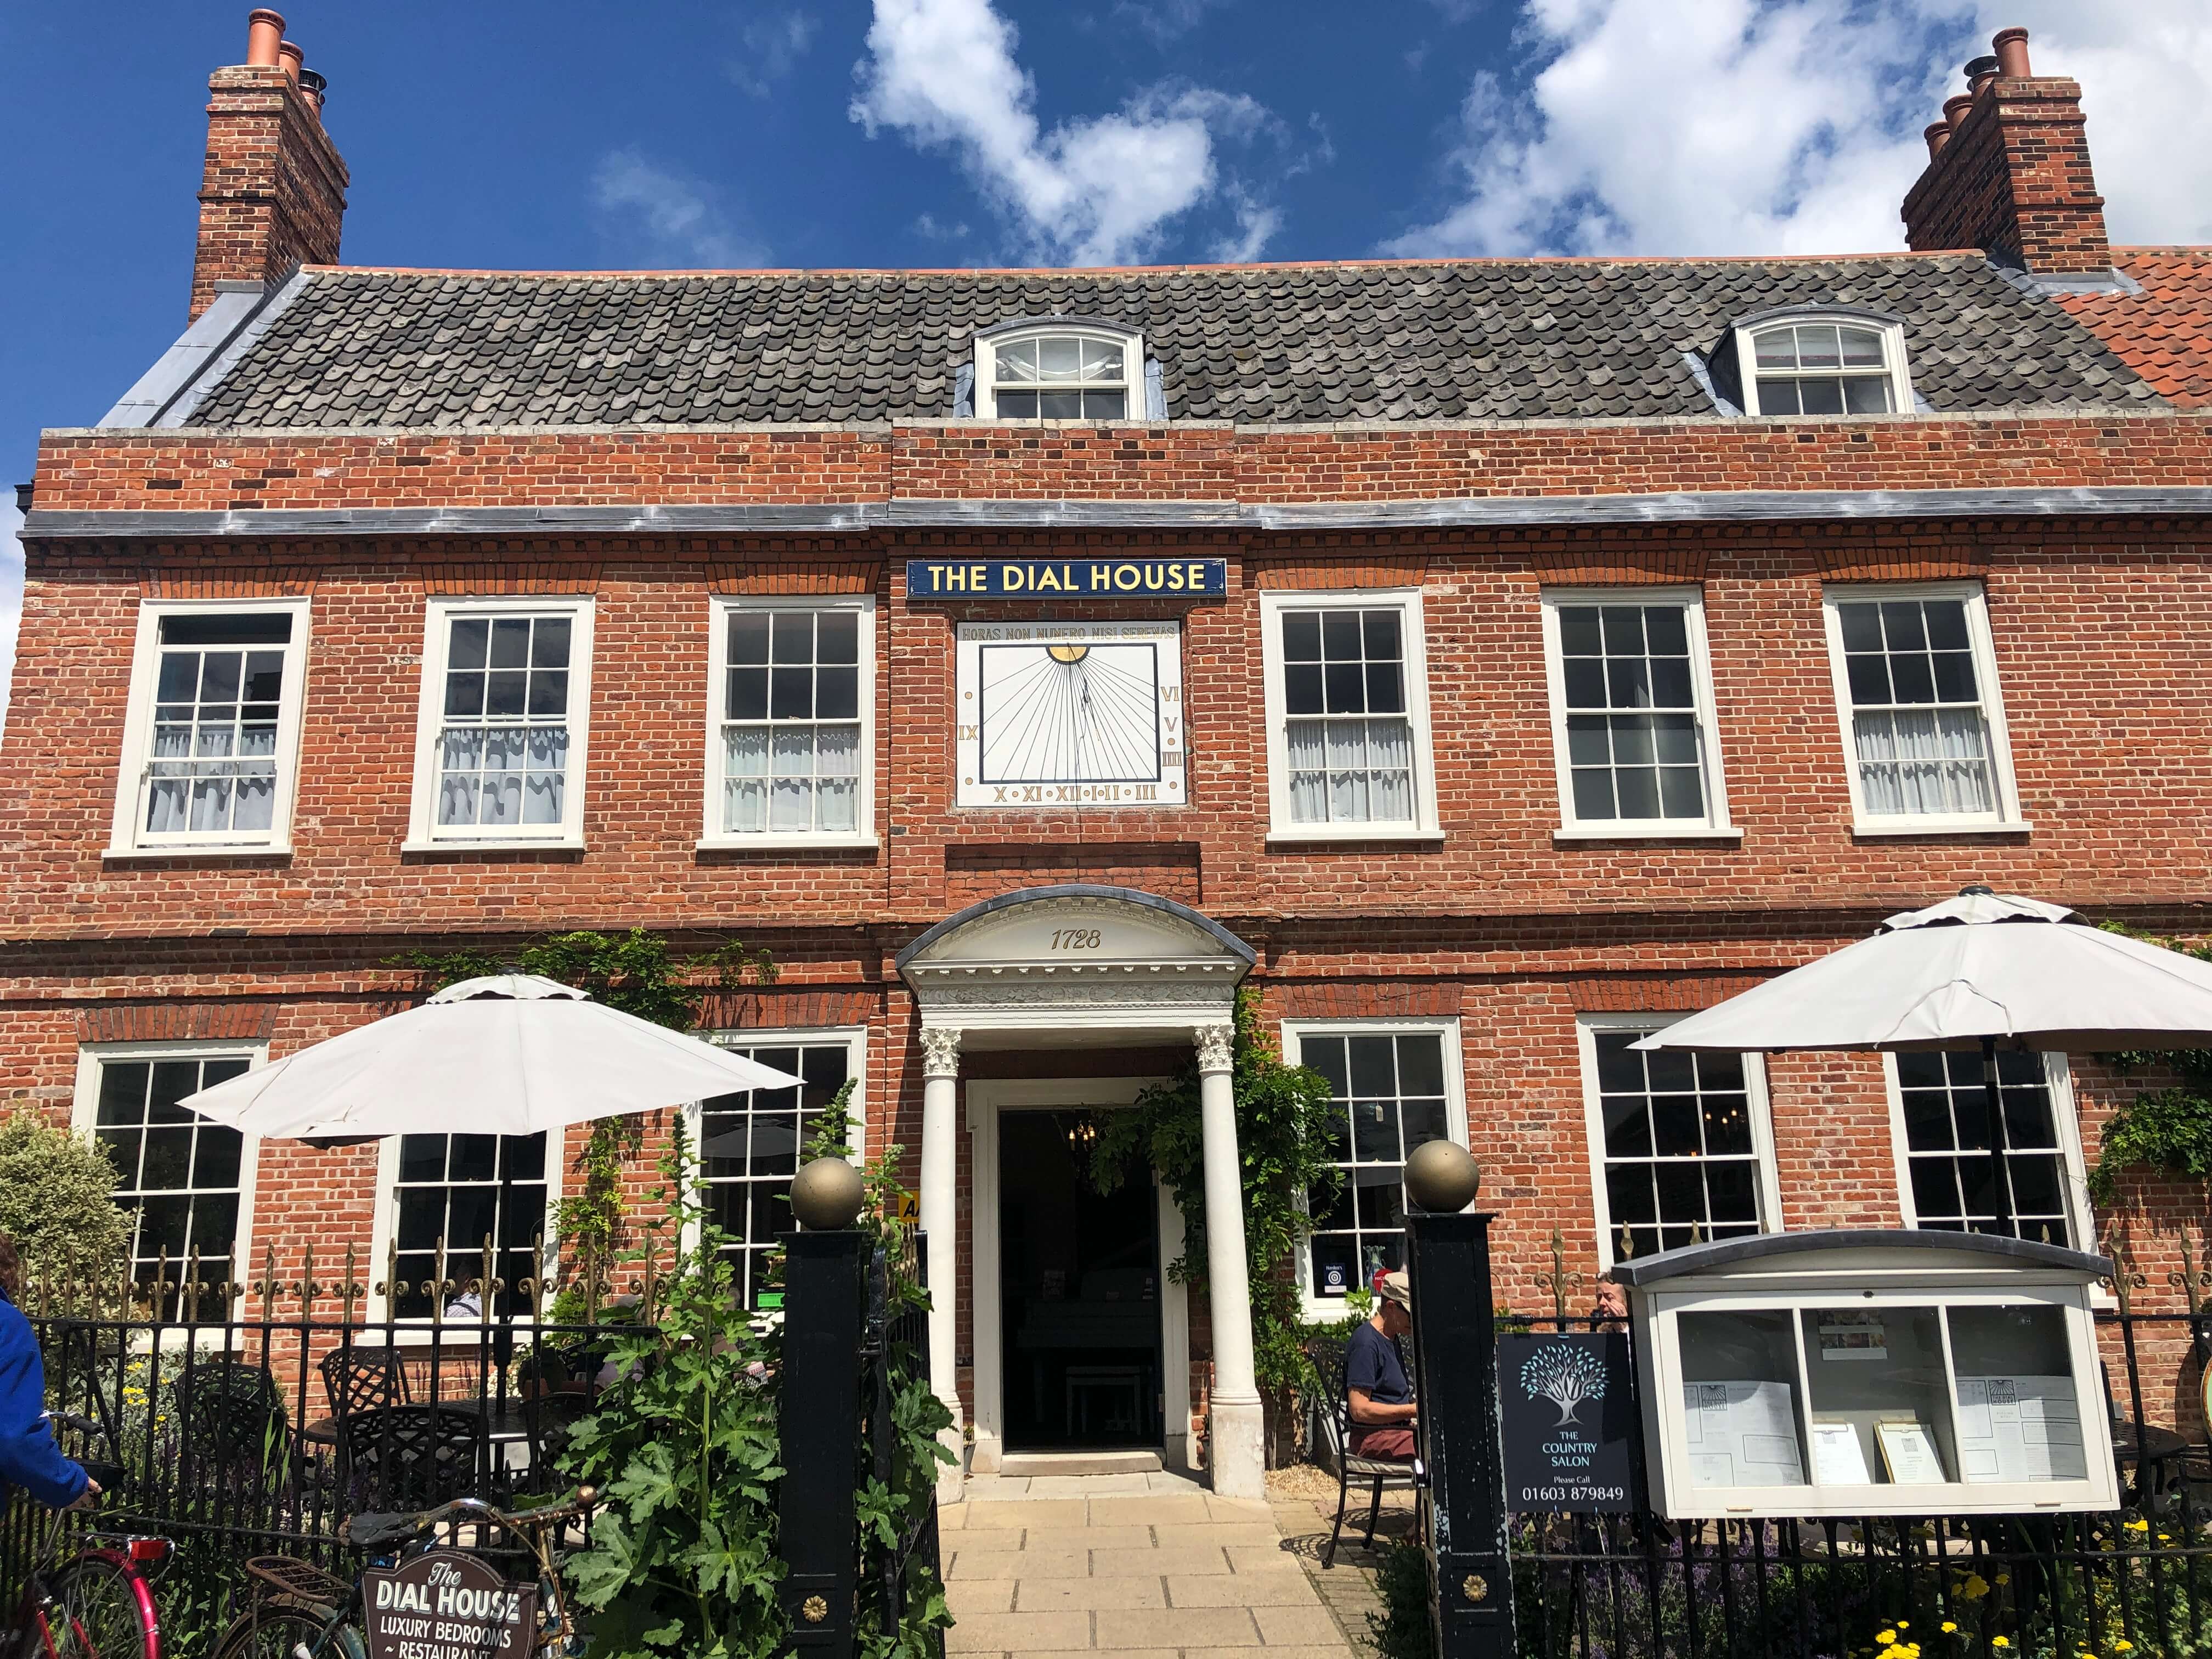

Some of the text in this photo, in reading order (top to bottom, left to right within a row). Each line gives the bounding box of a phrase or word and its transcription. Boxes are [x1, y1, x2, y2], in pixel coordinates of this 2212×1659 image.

[928, 564, 1205, 591] THE DIAL HOUSE
[962, 627, 1176, 641] HORAS NON NUMERO NISI SERENAS
[1160, 686, 1180, 702] VI
[1164, 717, 1178, 732] V
[960, 726, 978, 740] IX
[994, 786, 1008, 802] X
[1022, 786, 1042, 802] XI
[1055, 786, 1082, 801] XII
[1135, 785, 1157, 800] III
[1051, 929, 1102, 950] 1728
[1560, 1431, 1578, 1440] THE
[1542, 1443, 1598, 1453] COUNTRY
[1551, 1457, 1589, 1467] SALON
[1522, 1487, 1624, 1501] 01603 879849
[427, 1562, 462, 1586] The
[376, 1579, 521, 1624] DIAL HOUSE
[381, 1616, 511, 1648] LUXURY BEDROOMS
